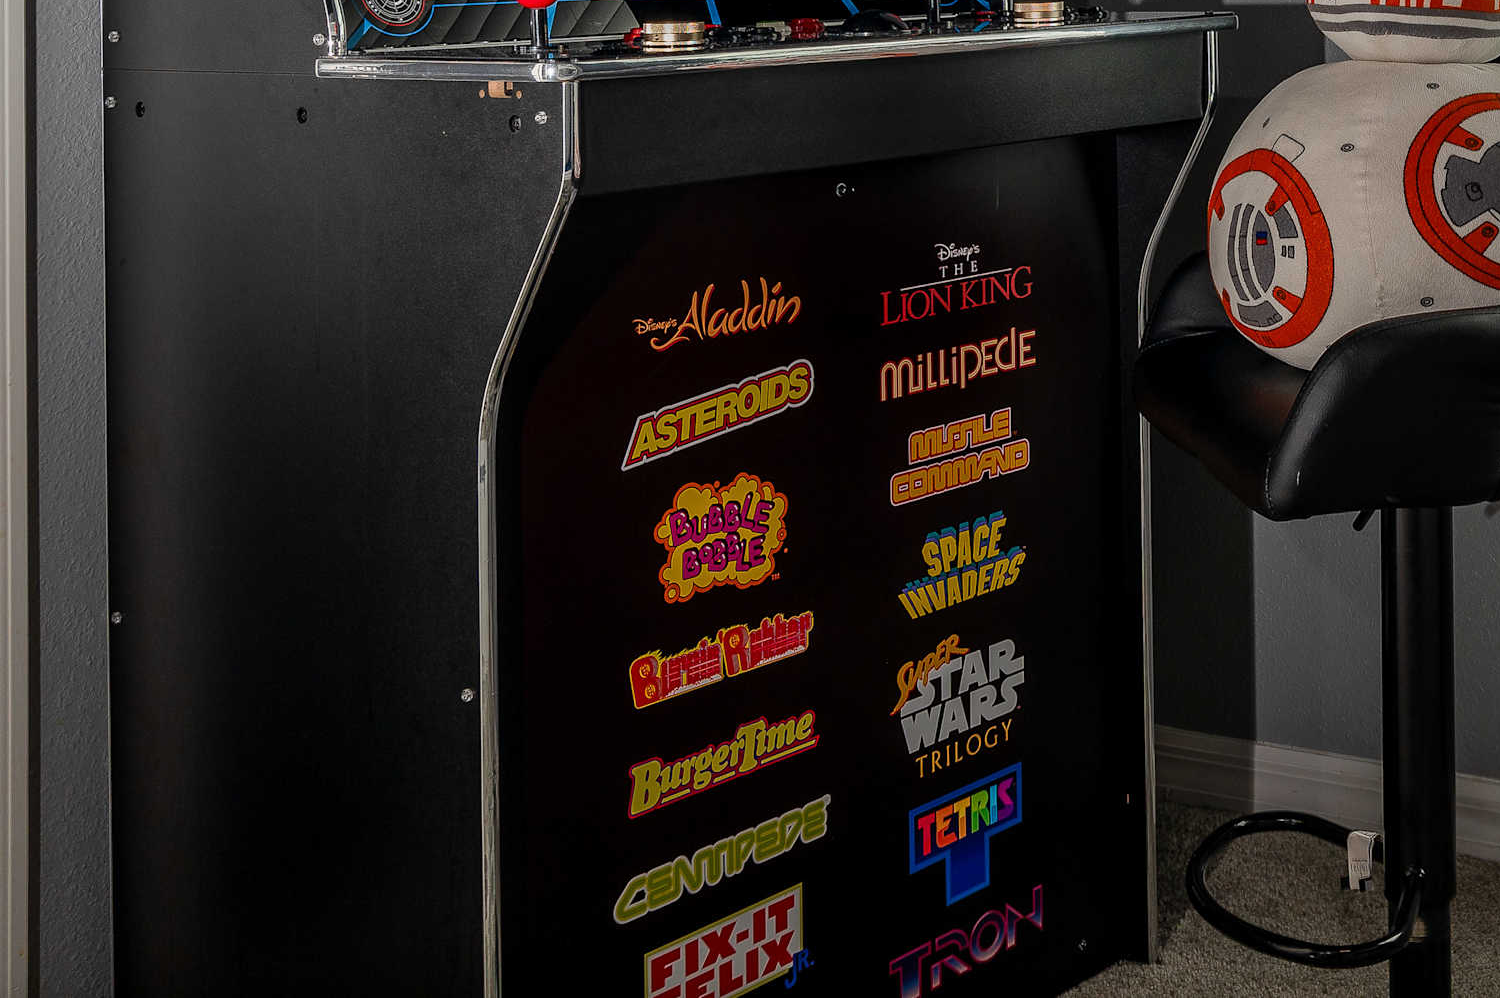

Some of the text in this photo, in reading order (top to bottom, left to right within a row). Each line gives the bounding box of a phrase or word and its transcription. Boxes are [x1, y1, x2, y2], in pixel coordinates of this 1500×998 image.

[880, 266, 1033, 326] LION KING
[939, 260, 979, 278] THE
[649, 276, 803, 353] Aladdin
[628, 363, 811, 463] ASTEROIDS
[909, 409, 1010, 463] MISSILE
[891, 440, 1029, 505] COMMAND
[669, 492, 774, 547] BUBBLE
[921, 513, 1007, 577] SPACE
[682, 532, 766, 580] BOBBLE
[898, 548, 1027, 620] INVADERS
[722, 610, 814, 678] Rubber
[901, 638, 1025, 717] STAR
[901, 671, 1025, 755] WARS
[916, 718, 1013, 778] TRILOGY
[917, 777, 1015, 857] TETRIS
[614, 798, 828, 924] CENTIPEDE
[651, 895, 795, 992] FIX-IT
[653, 930, 795, 998] ELIX
[889, 884, 1044, 998] TRON
